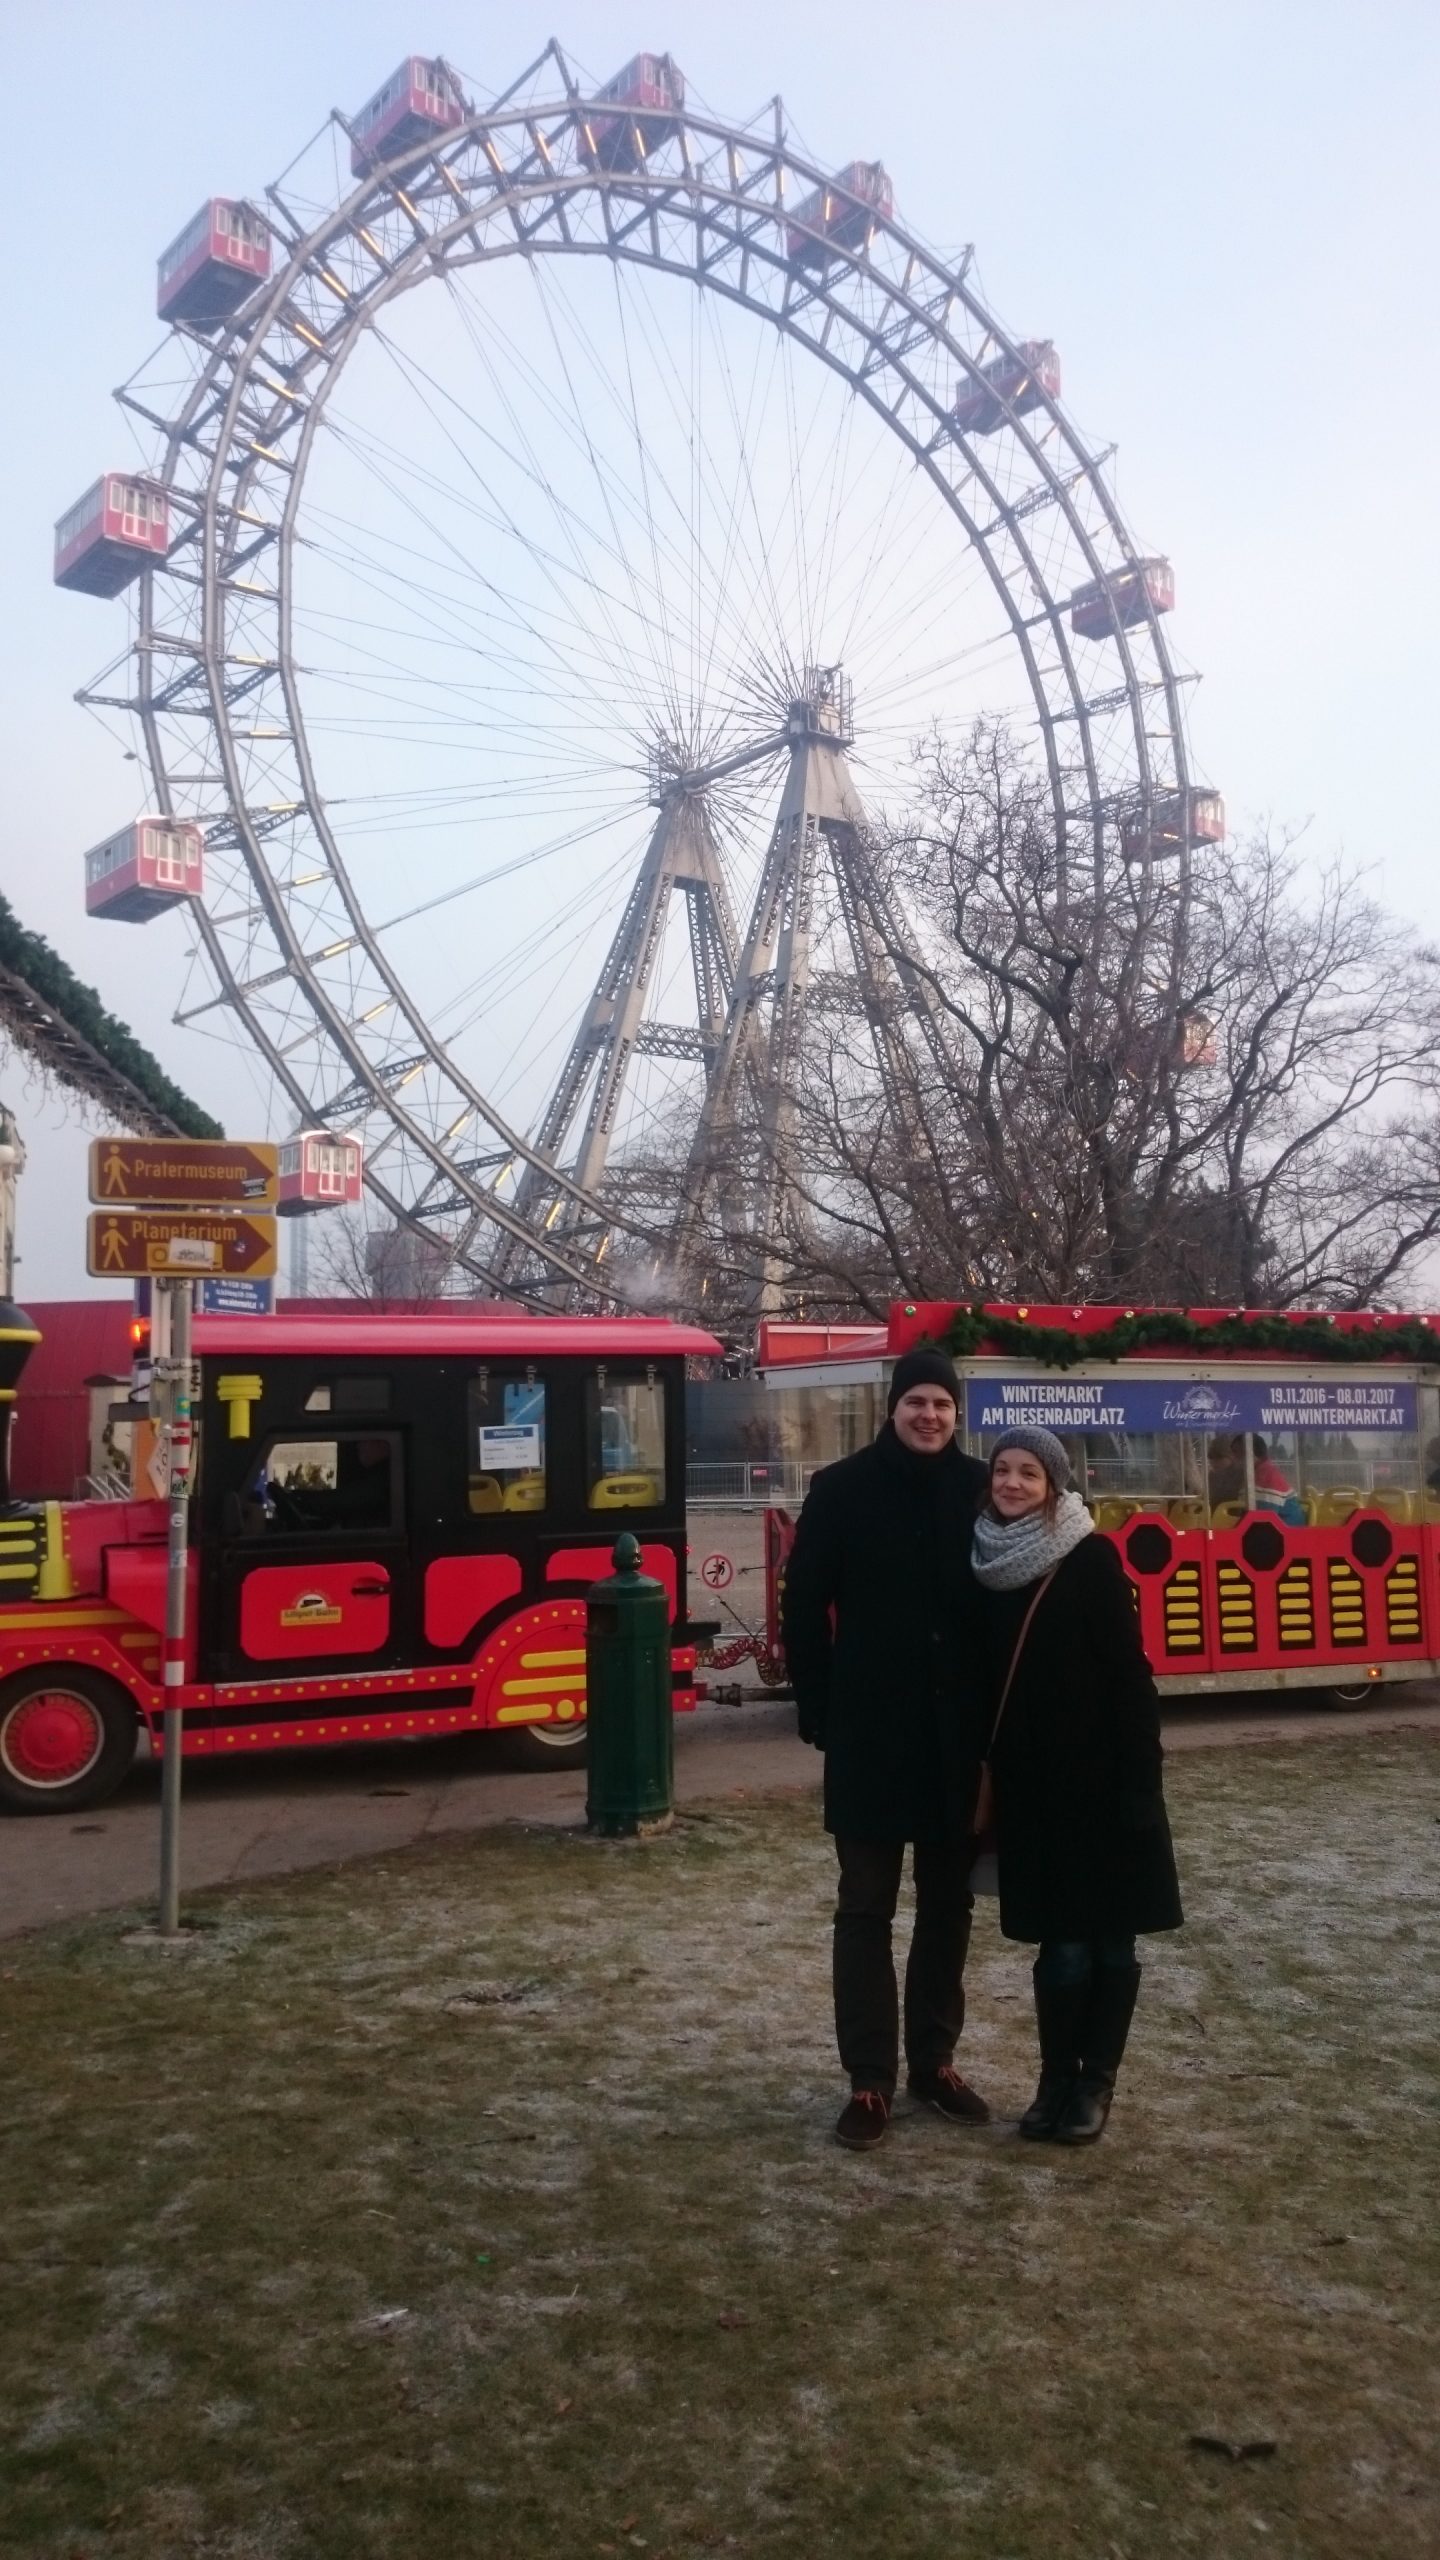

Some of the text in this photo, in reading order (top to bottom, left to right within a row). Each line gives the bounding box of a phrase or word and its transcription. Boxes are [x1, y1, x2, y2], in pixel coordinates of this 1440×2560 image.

[134, 1159, 247, 1180] Pratermuseum
[132, 1220, 237, 1241] Planetarium
[1002, 1385, 1103, 1403] WINTERMARKT
[1269, 1387, 1326, 1404] 19.11.2016
[1336, 1388, 1395, 1404] 08.01.2017
[981, 1407, 1125, 1425] AM RIESENRADPLATZ
[1161, 1400, 1241, 1420] Wintermarkt
[1261, 1408, 1405, 1425] WWW.WINTERMARKT.AT
